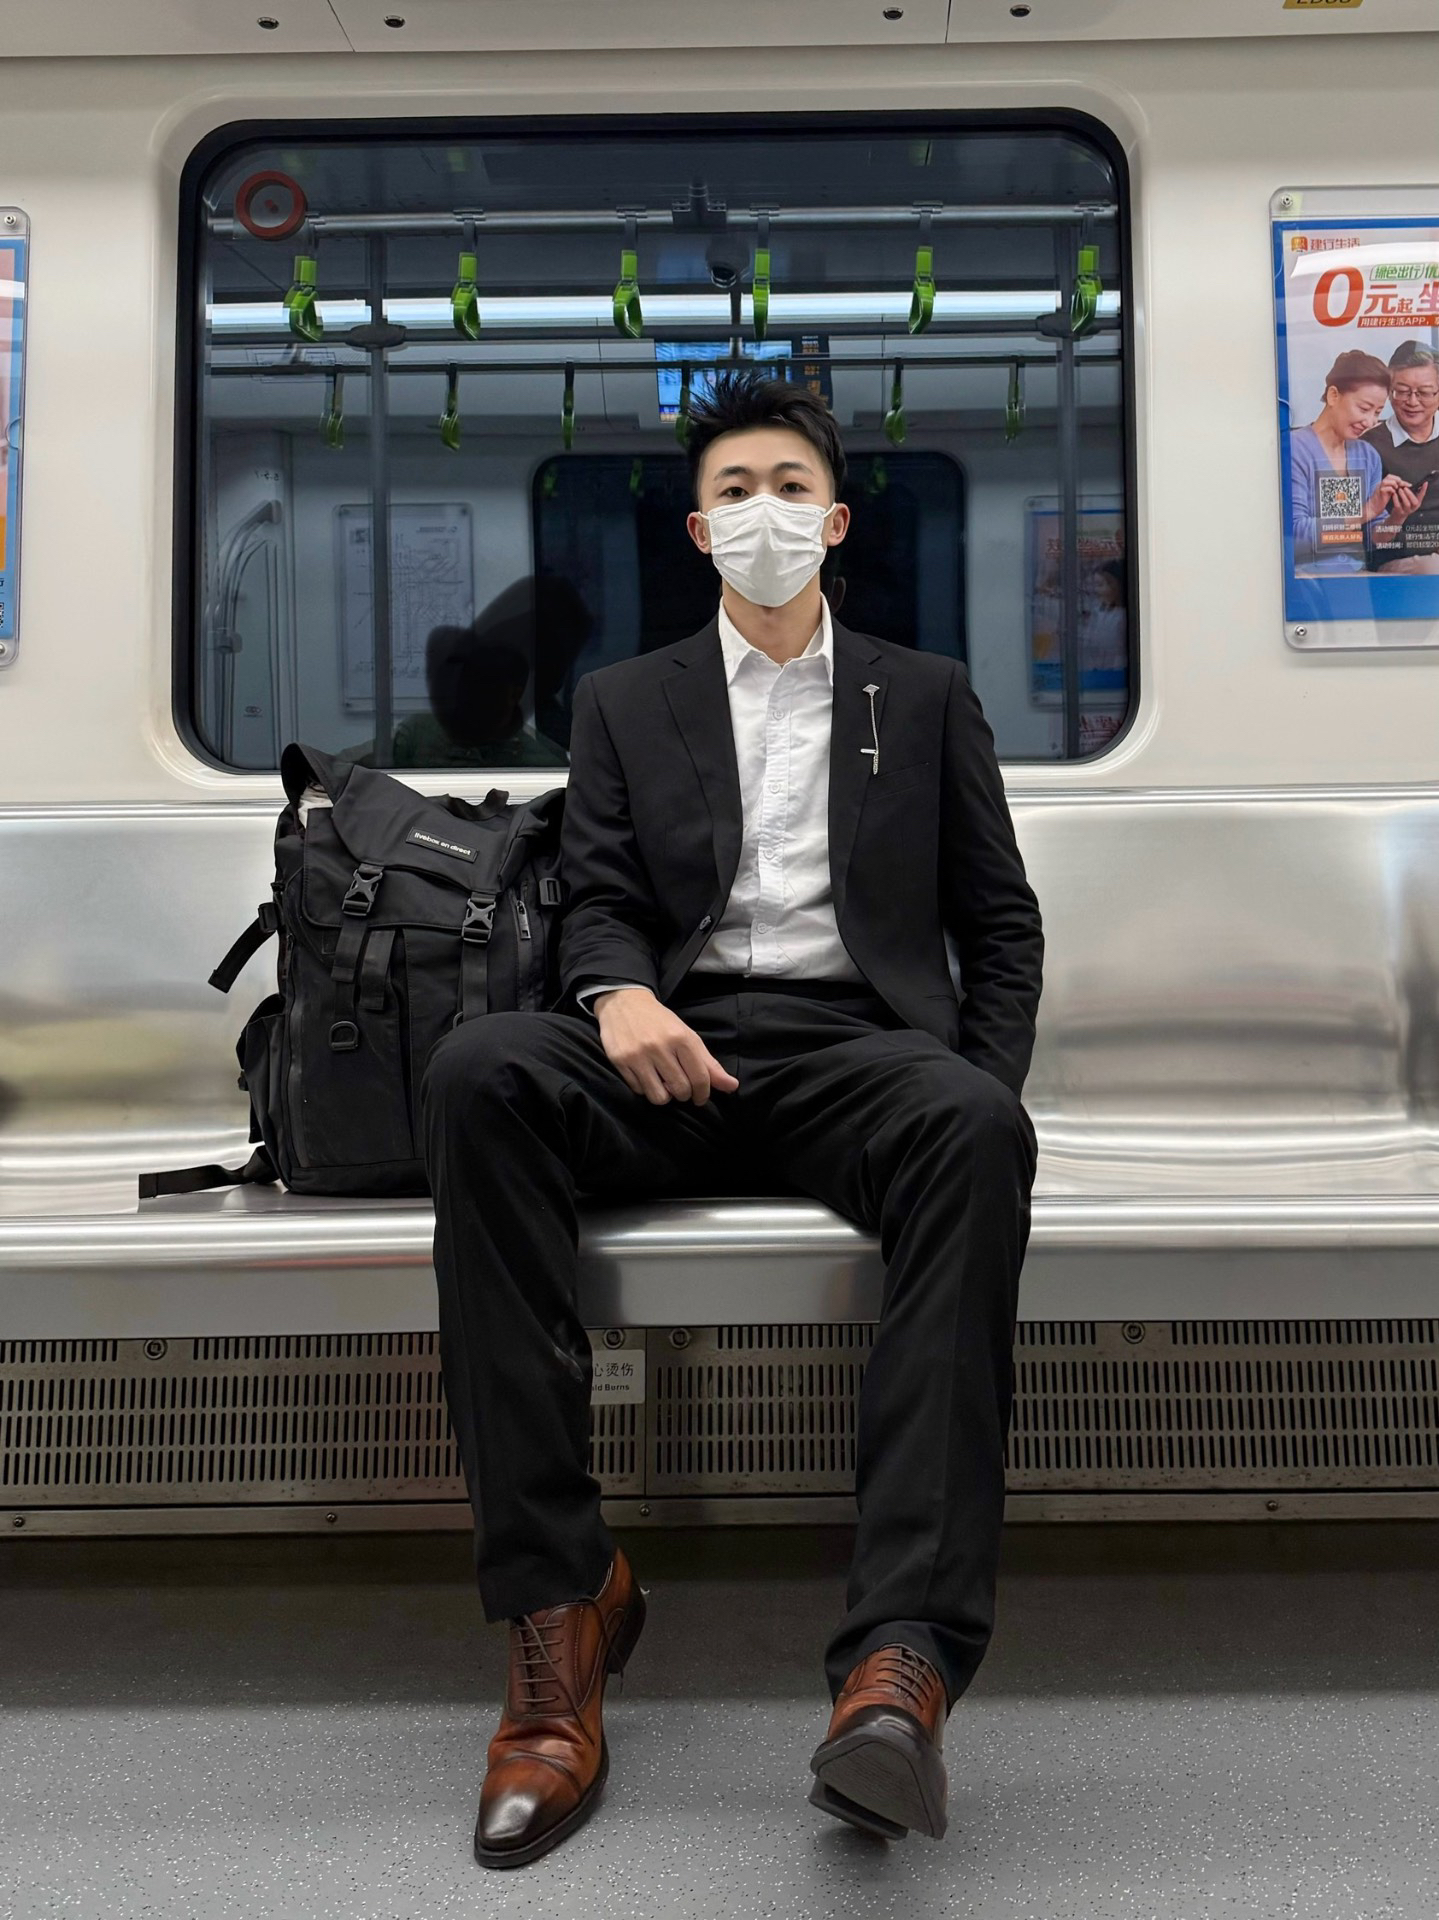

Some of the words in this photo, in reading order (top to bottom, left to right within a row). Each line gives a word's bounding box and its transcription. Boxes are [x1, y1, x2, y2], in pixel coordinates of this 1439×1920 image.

[1311, 238, 1360, 250] 建行生活
[604, 1383, 630, 1391] Burns
